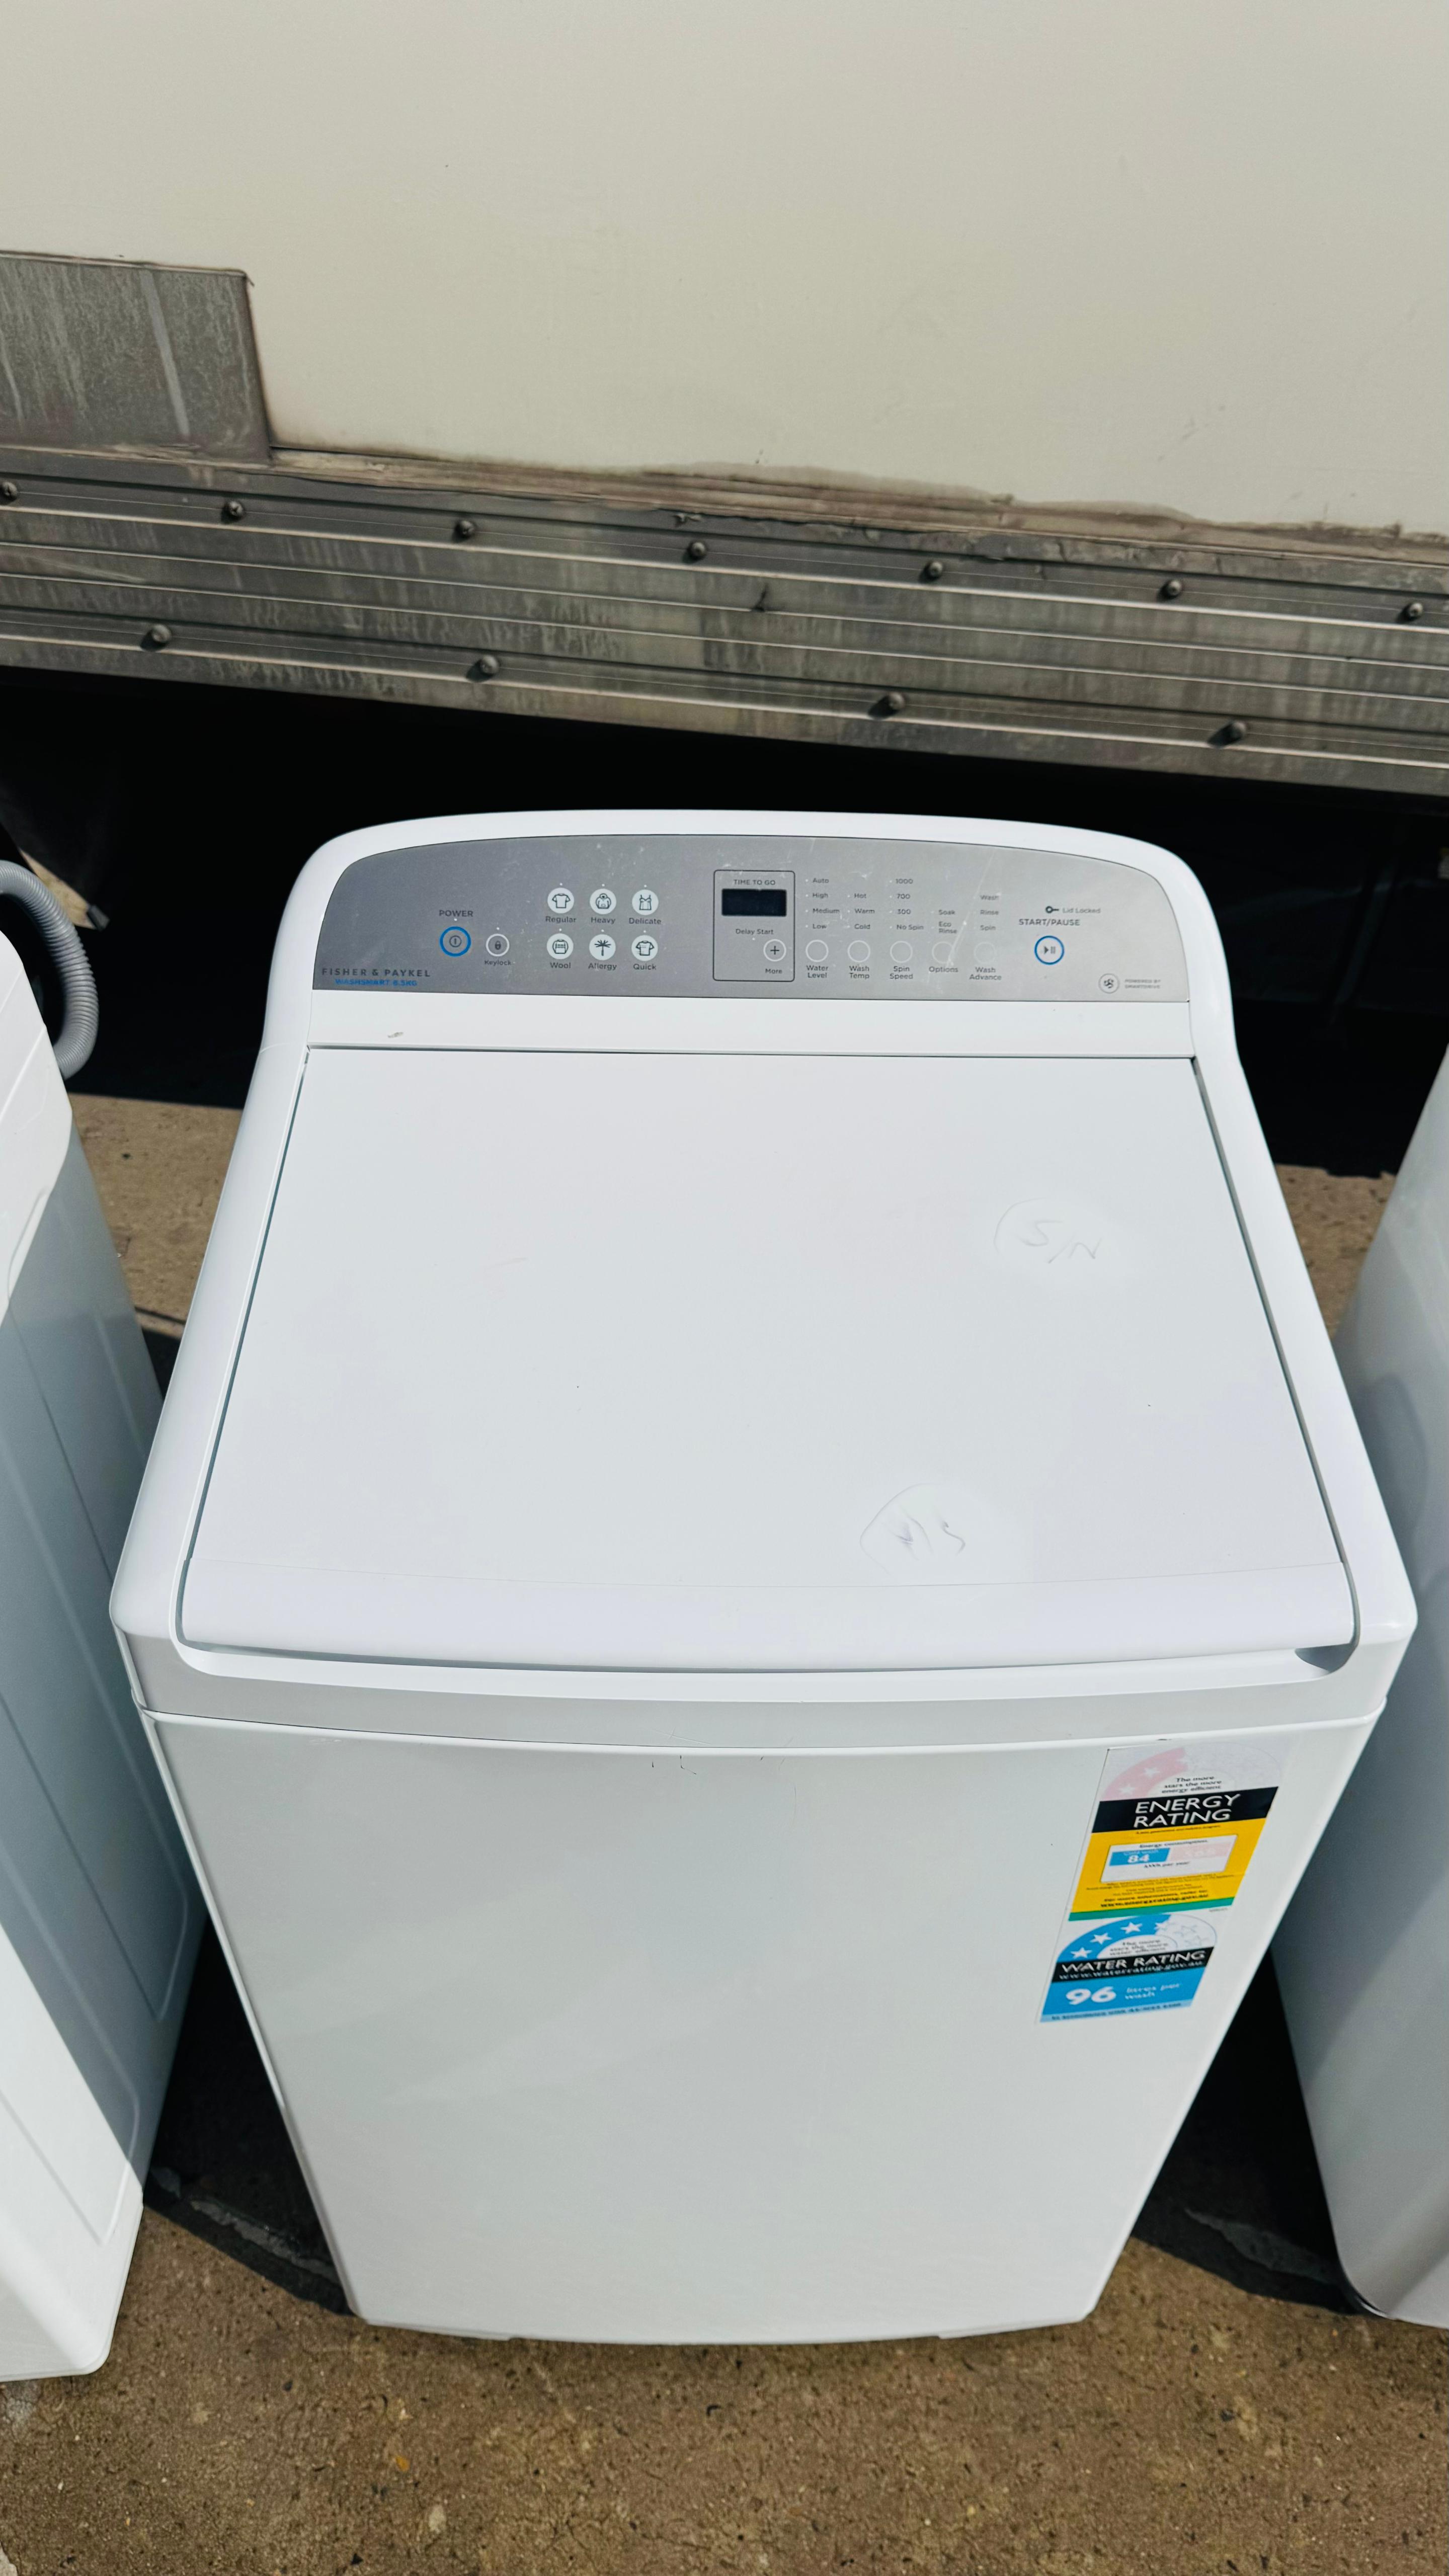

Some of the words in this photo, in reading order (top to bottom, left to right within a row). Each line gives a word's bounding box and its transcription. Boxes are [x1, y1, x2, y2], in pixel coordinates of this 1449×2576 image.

[545, 916, 576, 924] Regular
[1135, 1794, 1241, 1814] ENERGY
[1133, 1808, 1232, 1828] RATING
[1128, 1854, 1150, 1863] 84
[1061, 1959, 1127, 1973] WATER
[1133, 1950, 1206, 1967] RATING
[1066, 1986, 1116, 2005] 96
